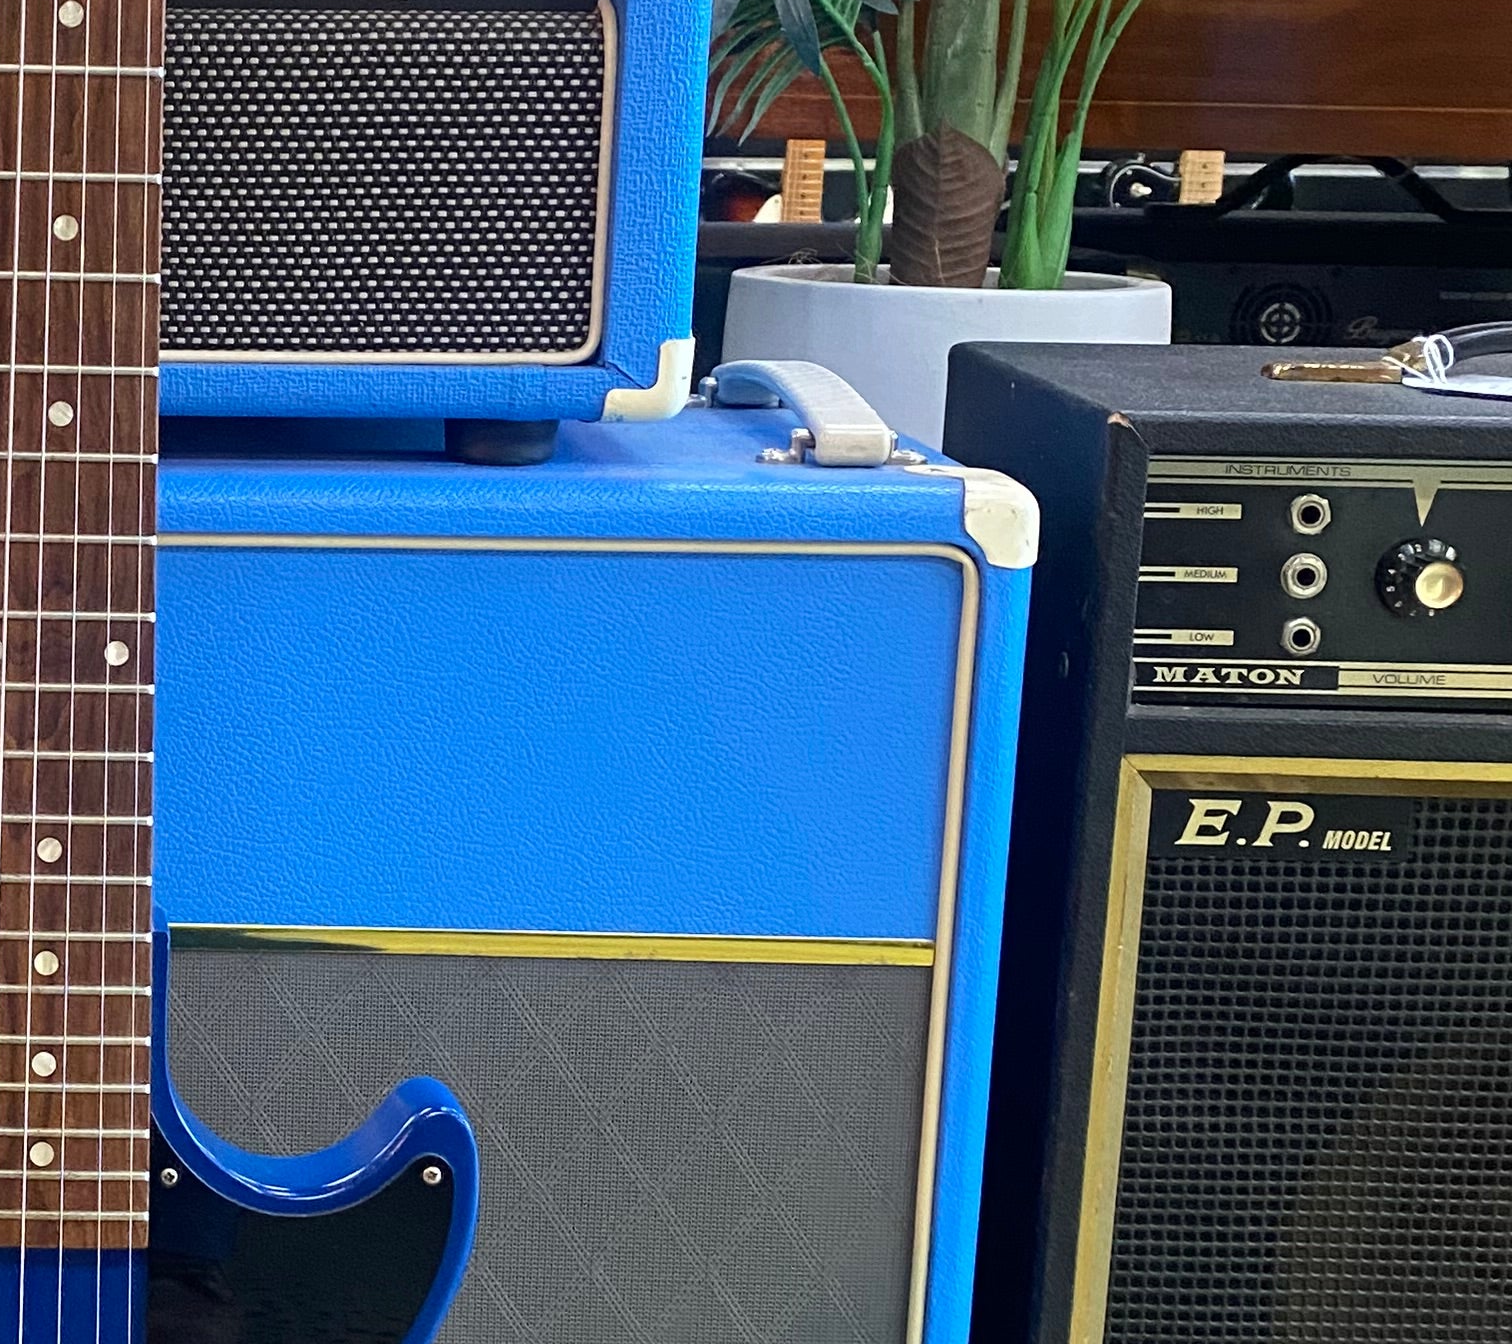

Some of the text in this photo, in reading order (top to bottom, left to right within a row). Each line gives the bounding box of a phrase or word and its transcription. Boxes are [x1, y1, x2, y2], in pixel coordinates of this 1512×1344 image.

[1225, 463, 1352, 477] INSTRUMENTS
[1196, 504, 1225, 516] HIGH
[1183, 567, 1228, 580] MEDIUM
[1188, 631, 1215, 643] LOW
[1152, 665, 1306, 686] MATON
[1372, 672, 1448, 687] VOLUME
[1174, 799, 1393, 852] E.P. MODEL
